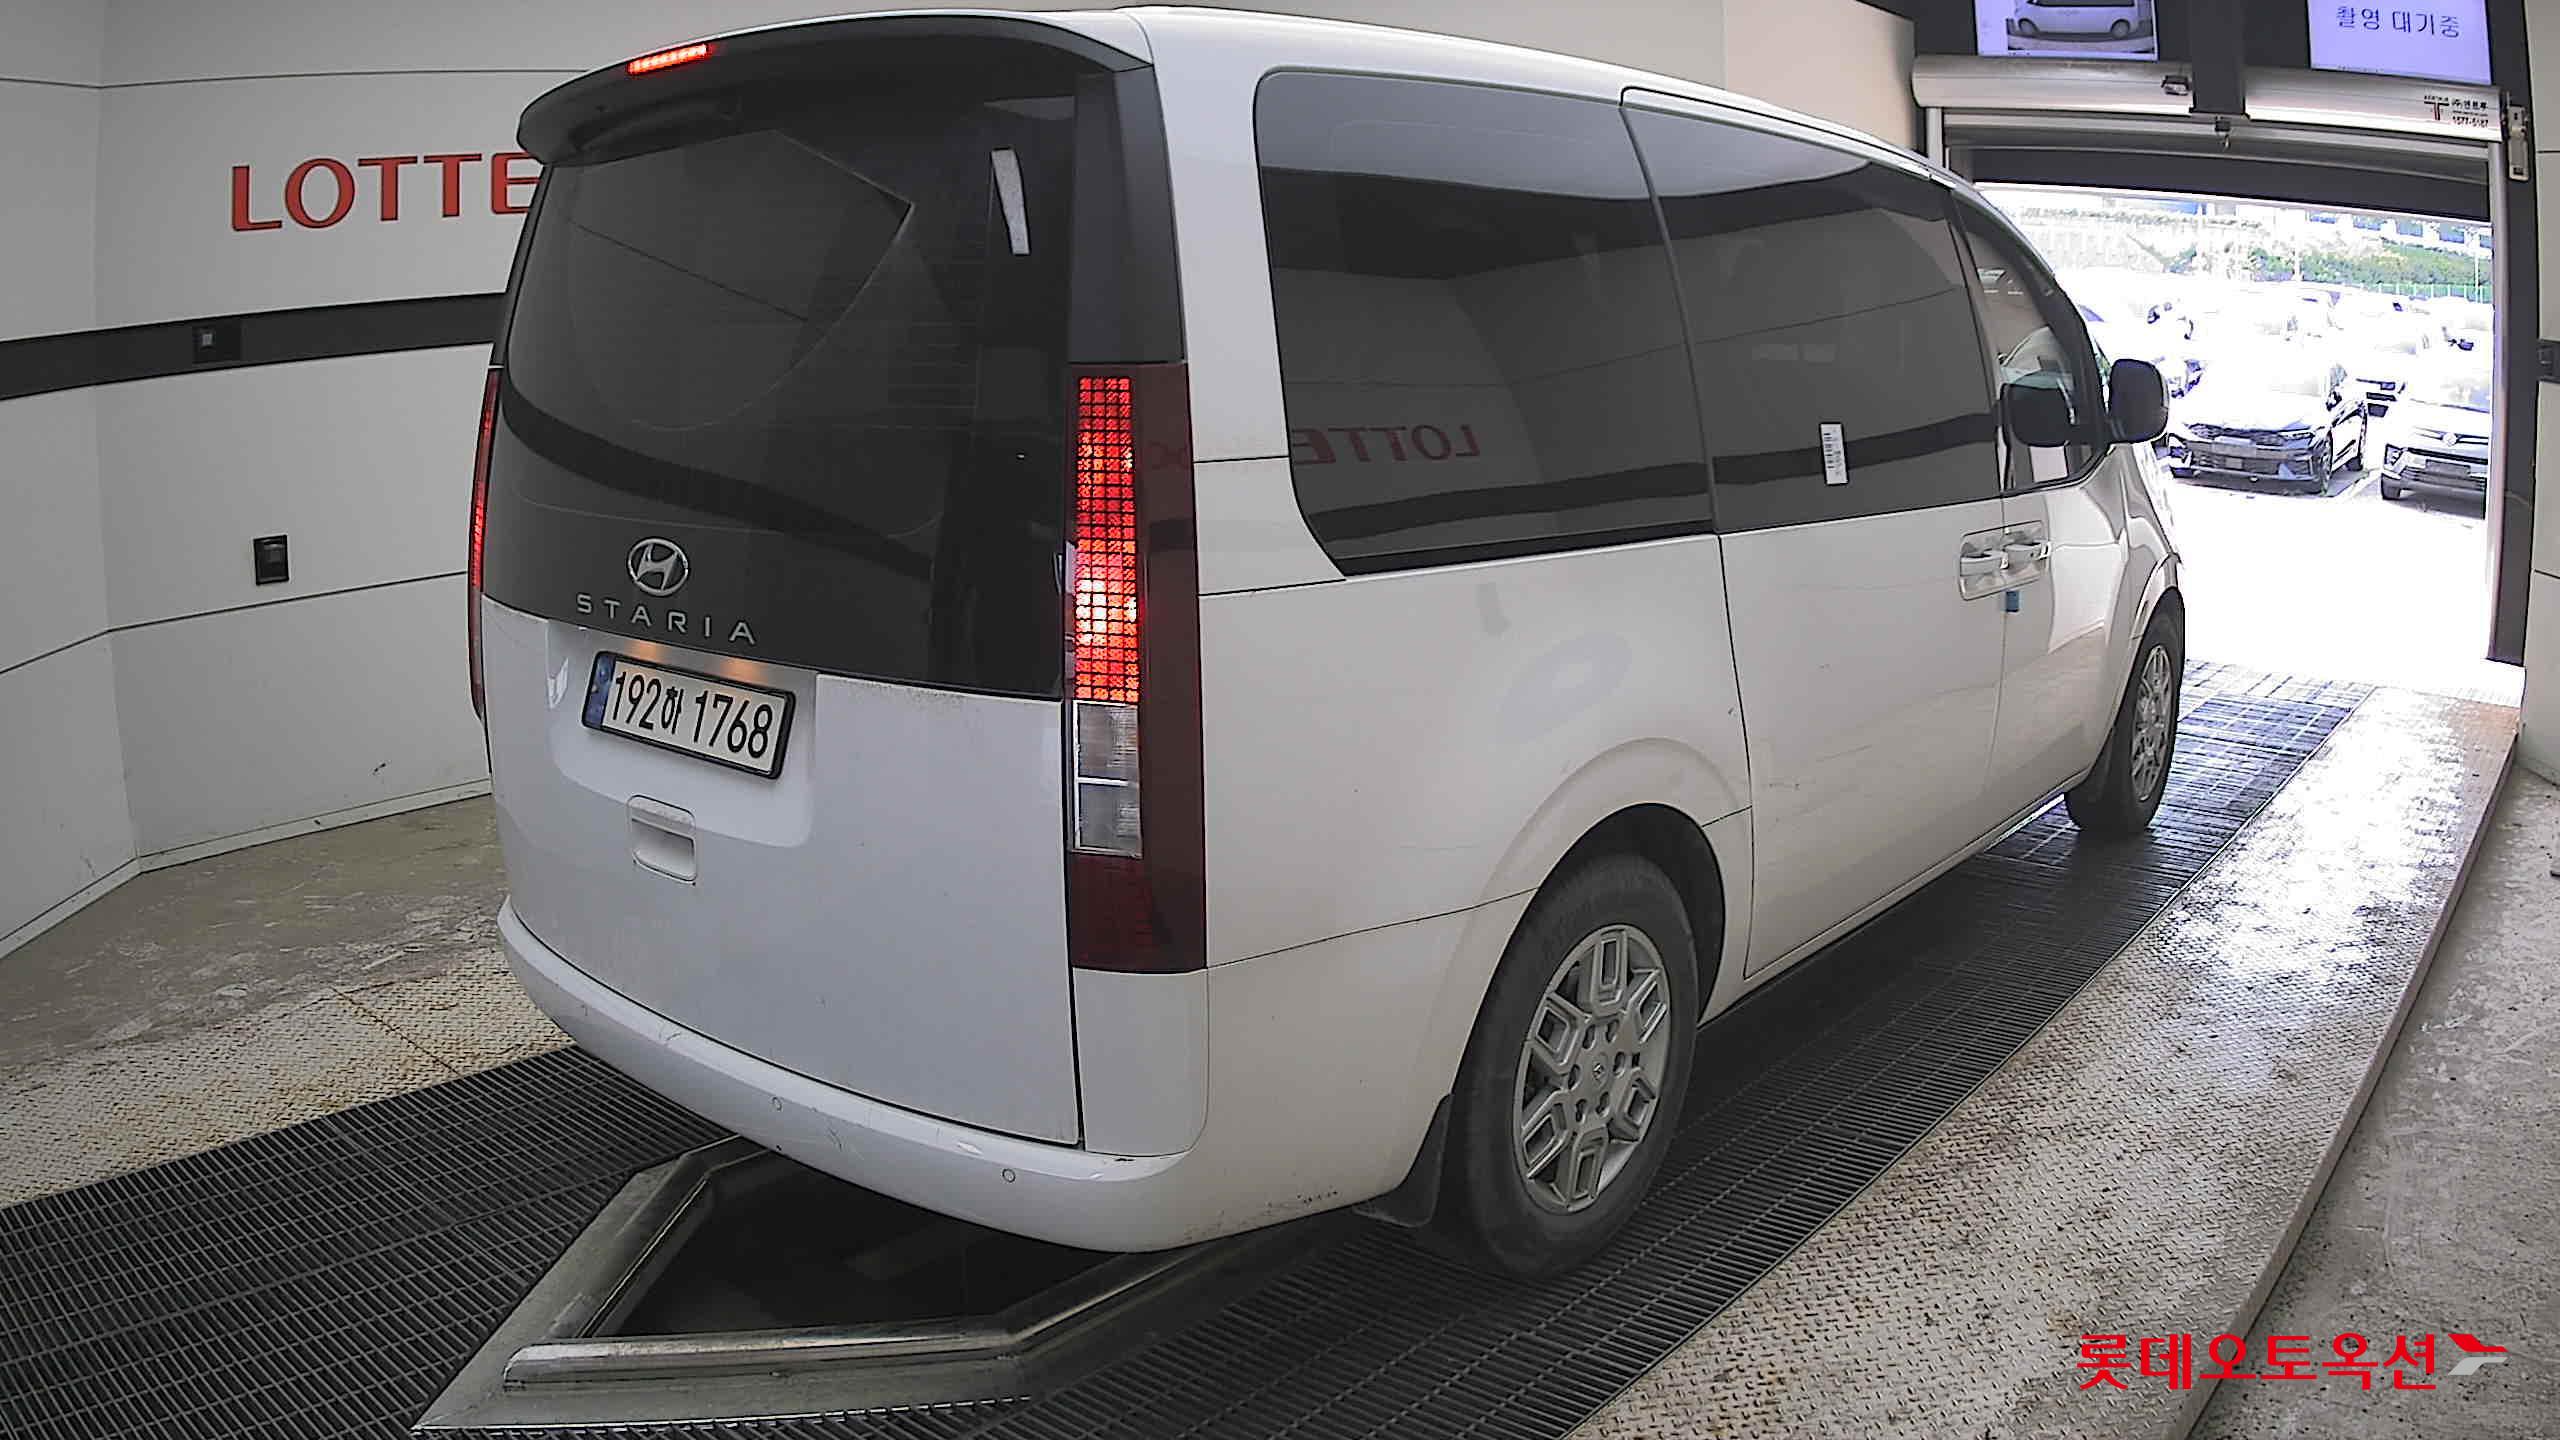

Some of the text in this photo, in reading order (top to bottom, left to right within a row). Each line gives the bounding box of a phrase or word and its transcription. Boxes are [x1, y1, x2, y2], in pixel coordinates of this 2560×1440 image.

[2337, 6, 2460, 39] 촬영 대기중
[231, 152, 541, 232] LOTTE
[576, 593, 756, 645] STARIA
[612, 671, 774, 759] 192하 1768
